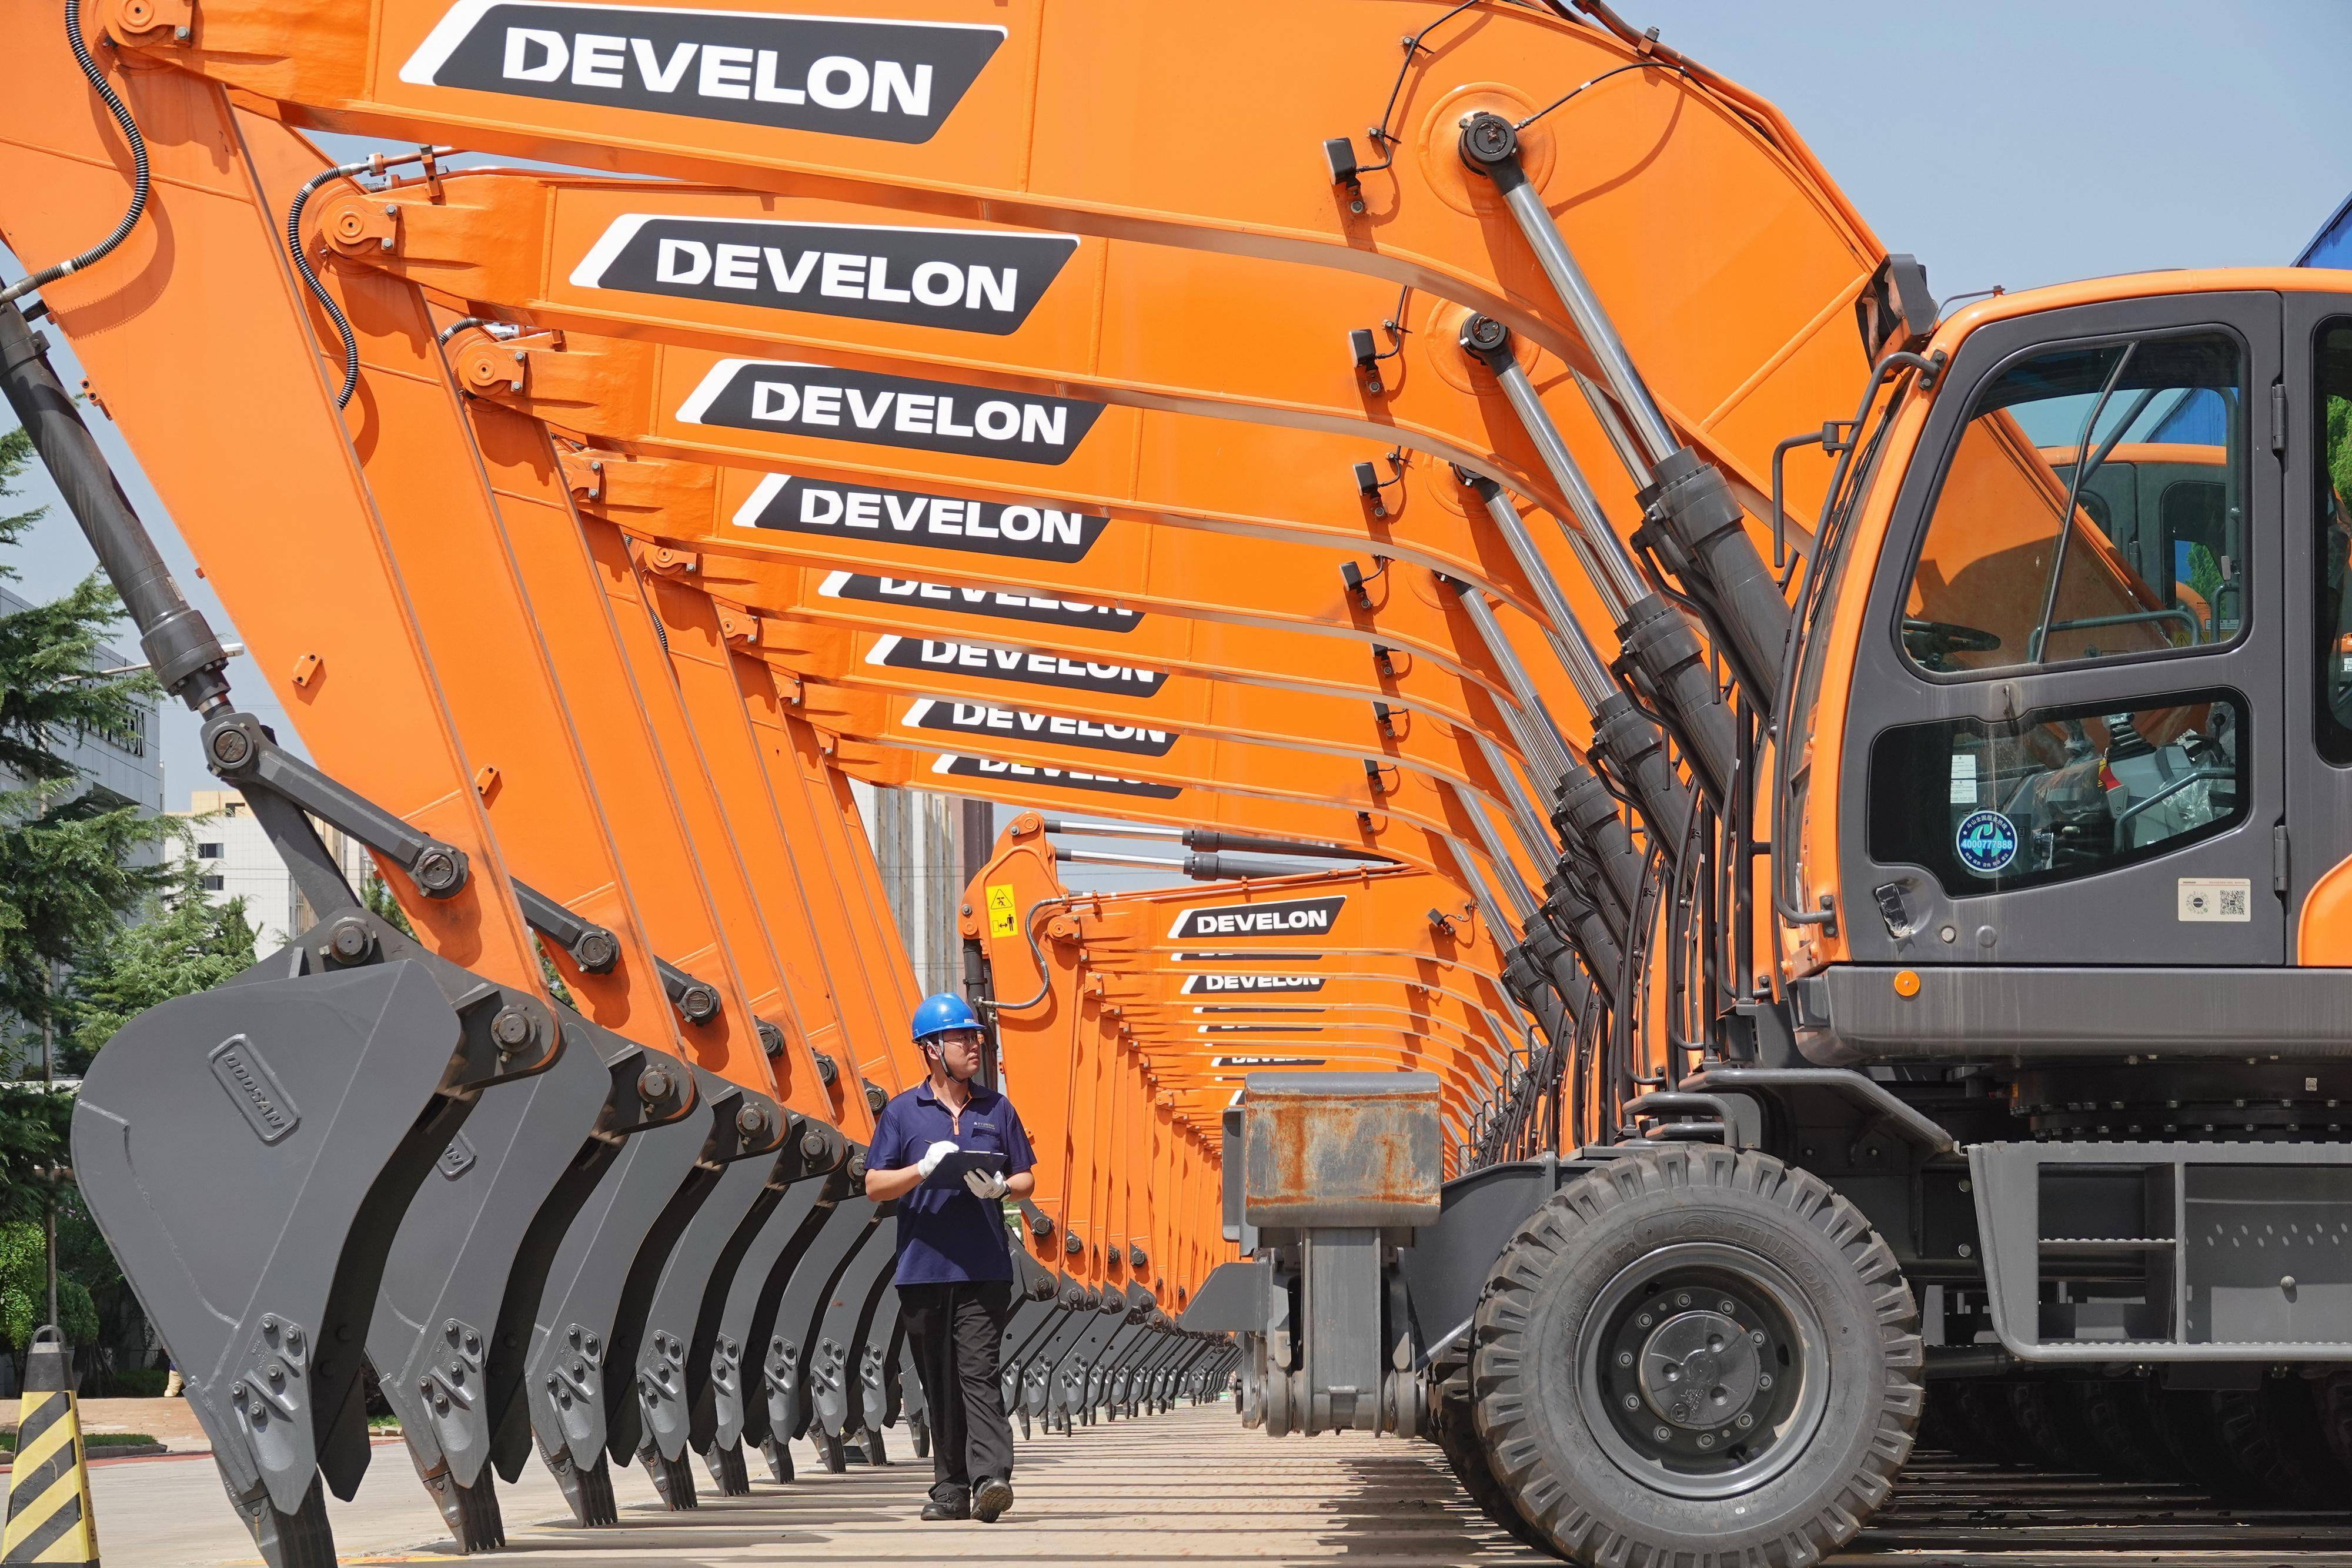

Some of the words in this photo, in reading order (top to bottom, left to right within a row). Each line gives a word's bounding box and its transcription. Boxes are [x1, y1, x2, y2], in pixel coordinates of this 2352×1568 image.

[503, 27, 933, 116] DEVELON
[656, 238, 1018, 312] DEVELON
[751, 381, 1067, 445] DEVELON
[800, 488, 1082, 545] DEVELON
[1961, 839, 2013, 850] 4000777888
[1197, 909, 1328, 934] DEVELON
[220, 1051, 286, 1129] DOOSAN
